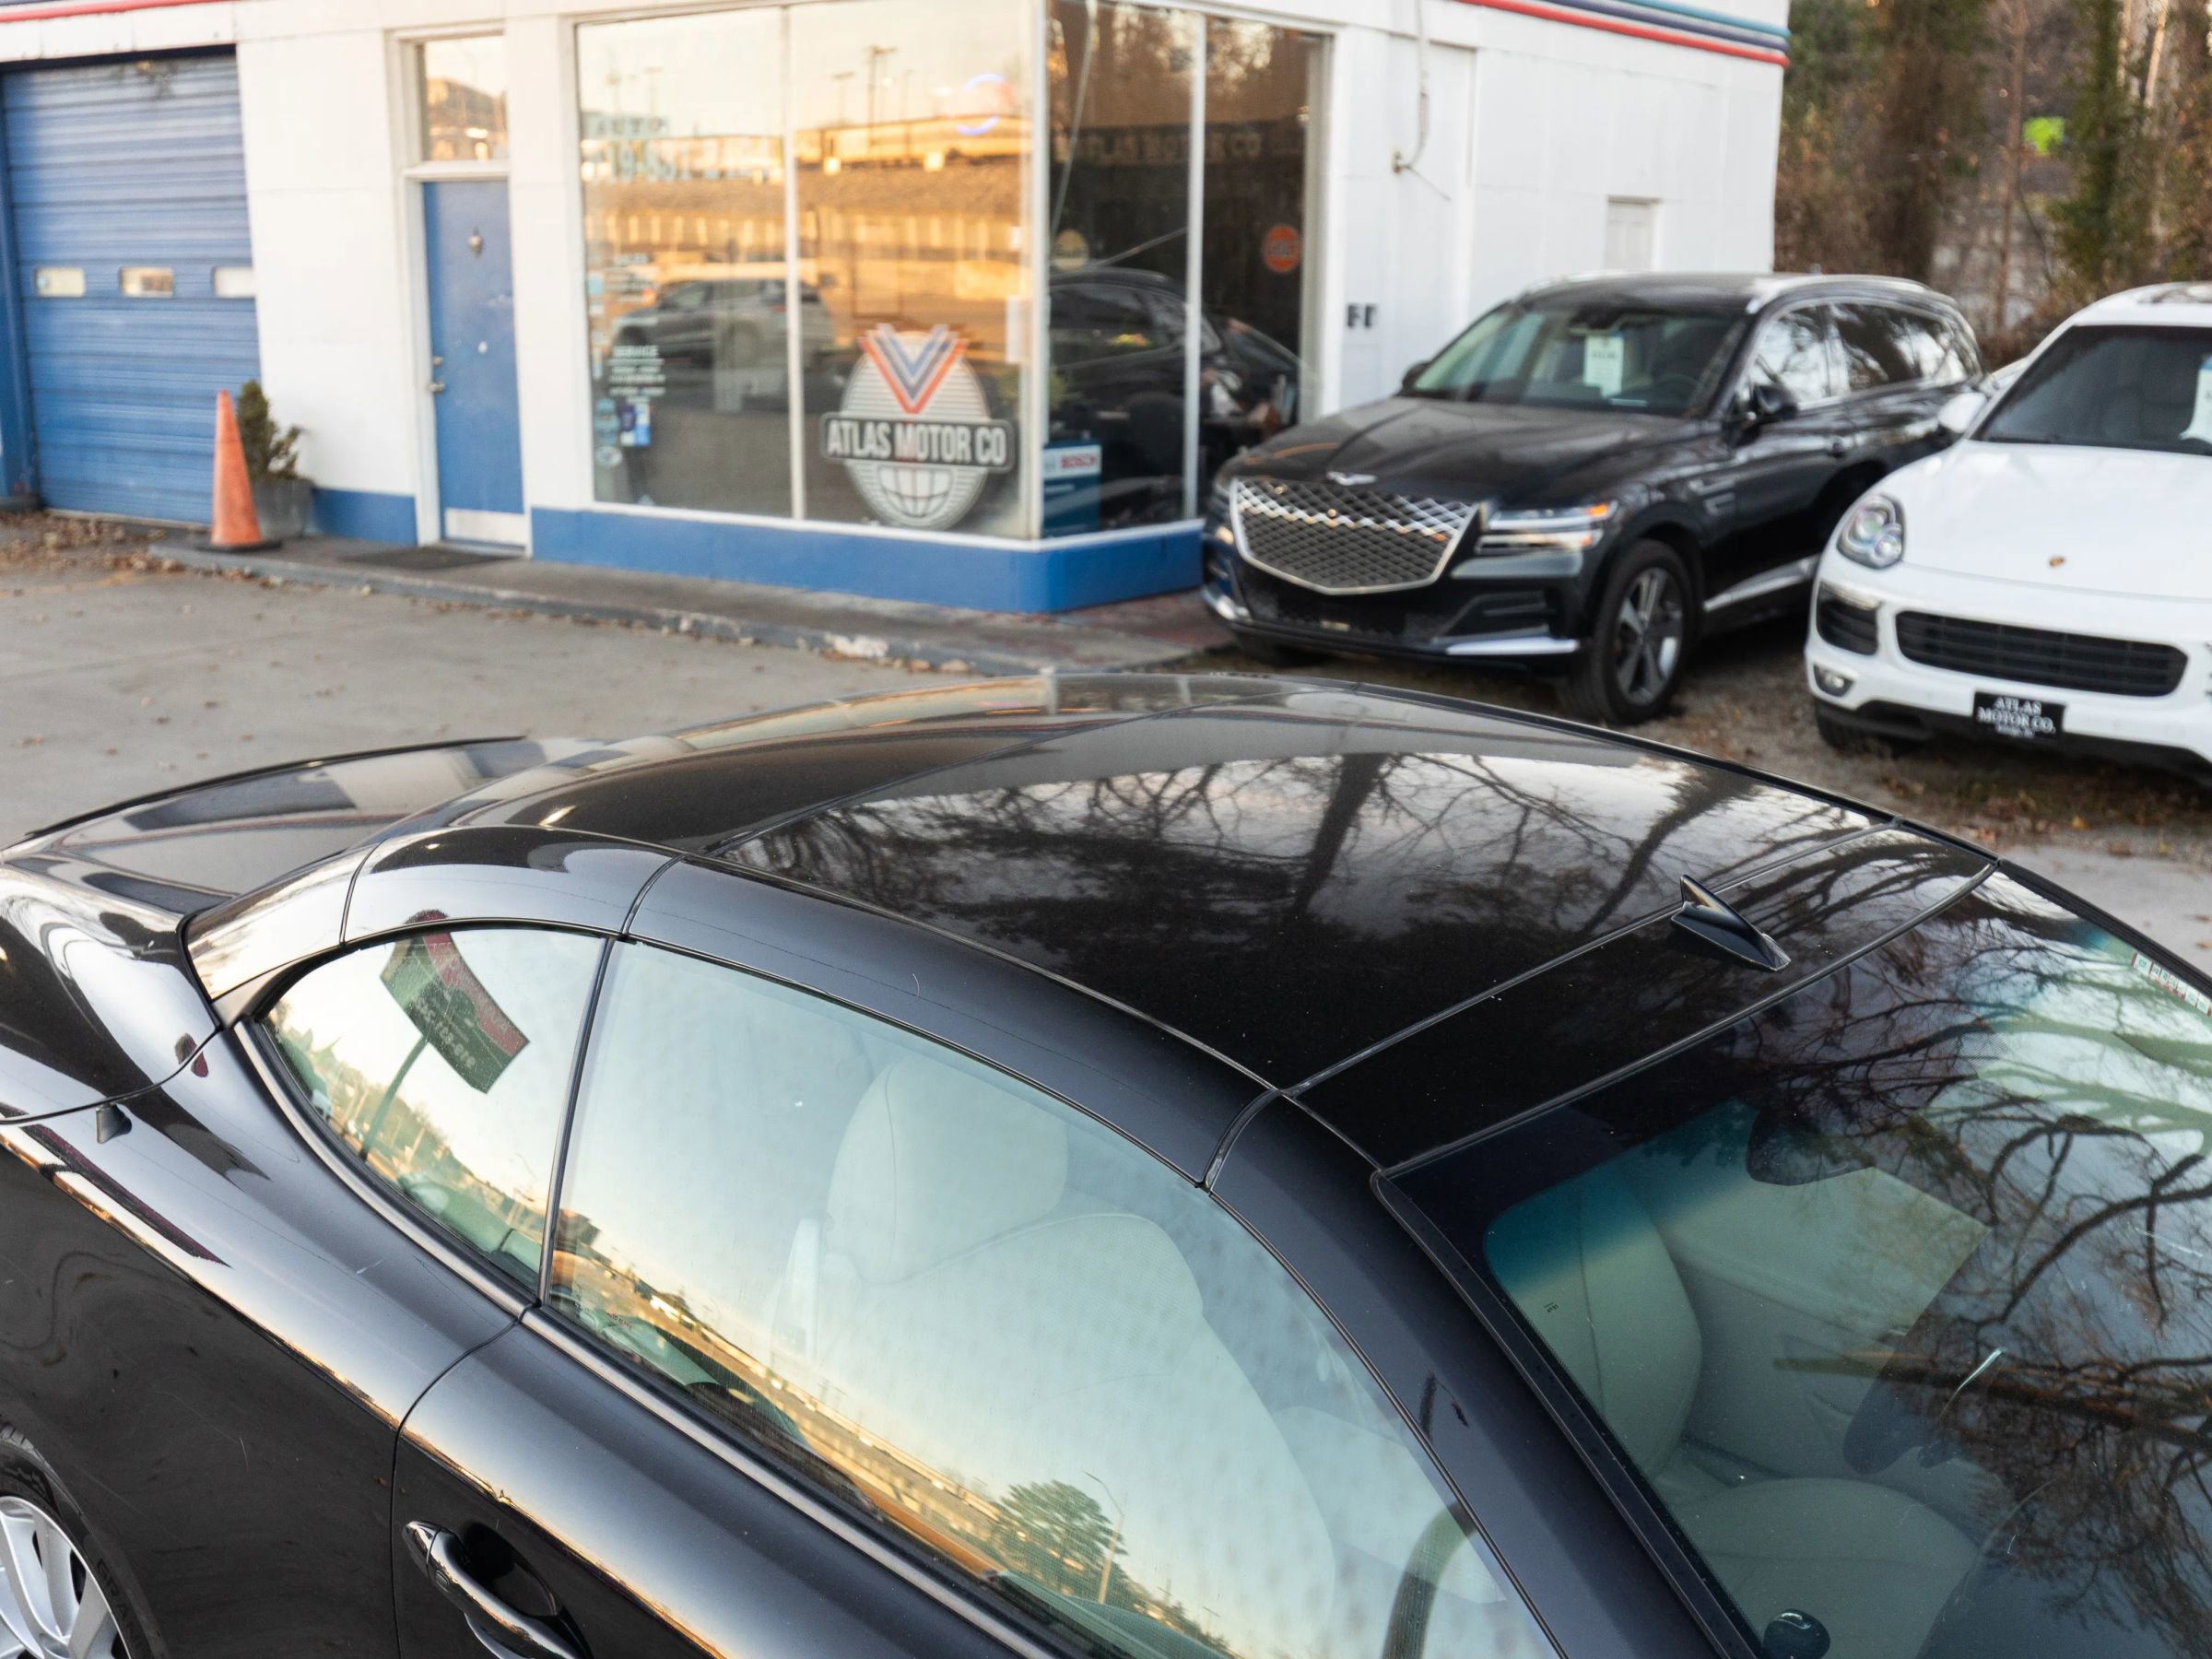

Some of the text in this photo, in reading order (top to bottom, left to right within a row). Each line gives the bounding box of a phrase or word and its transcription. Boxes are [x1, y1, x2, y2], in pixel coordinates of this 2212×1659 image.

[827, 419, 1006, 465] ATLAS MOTOR CO
[1976, 706, 2030, 728] MOTOR
[1993, 696, 2041, 717] ATLAS
